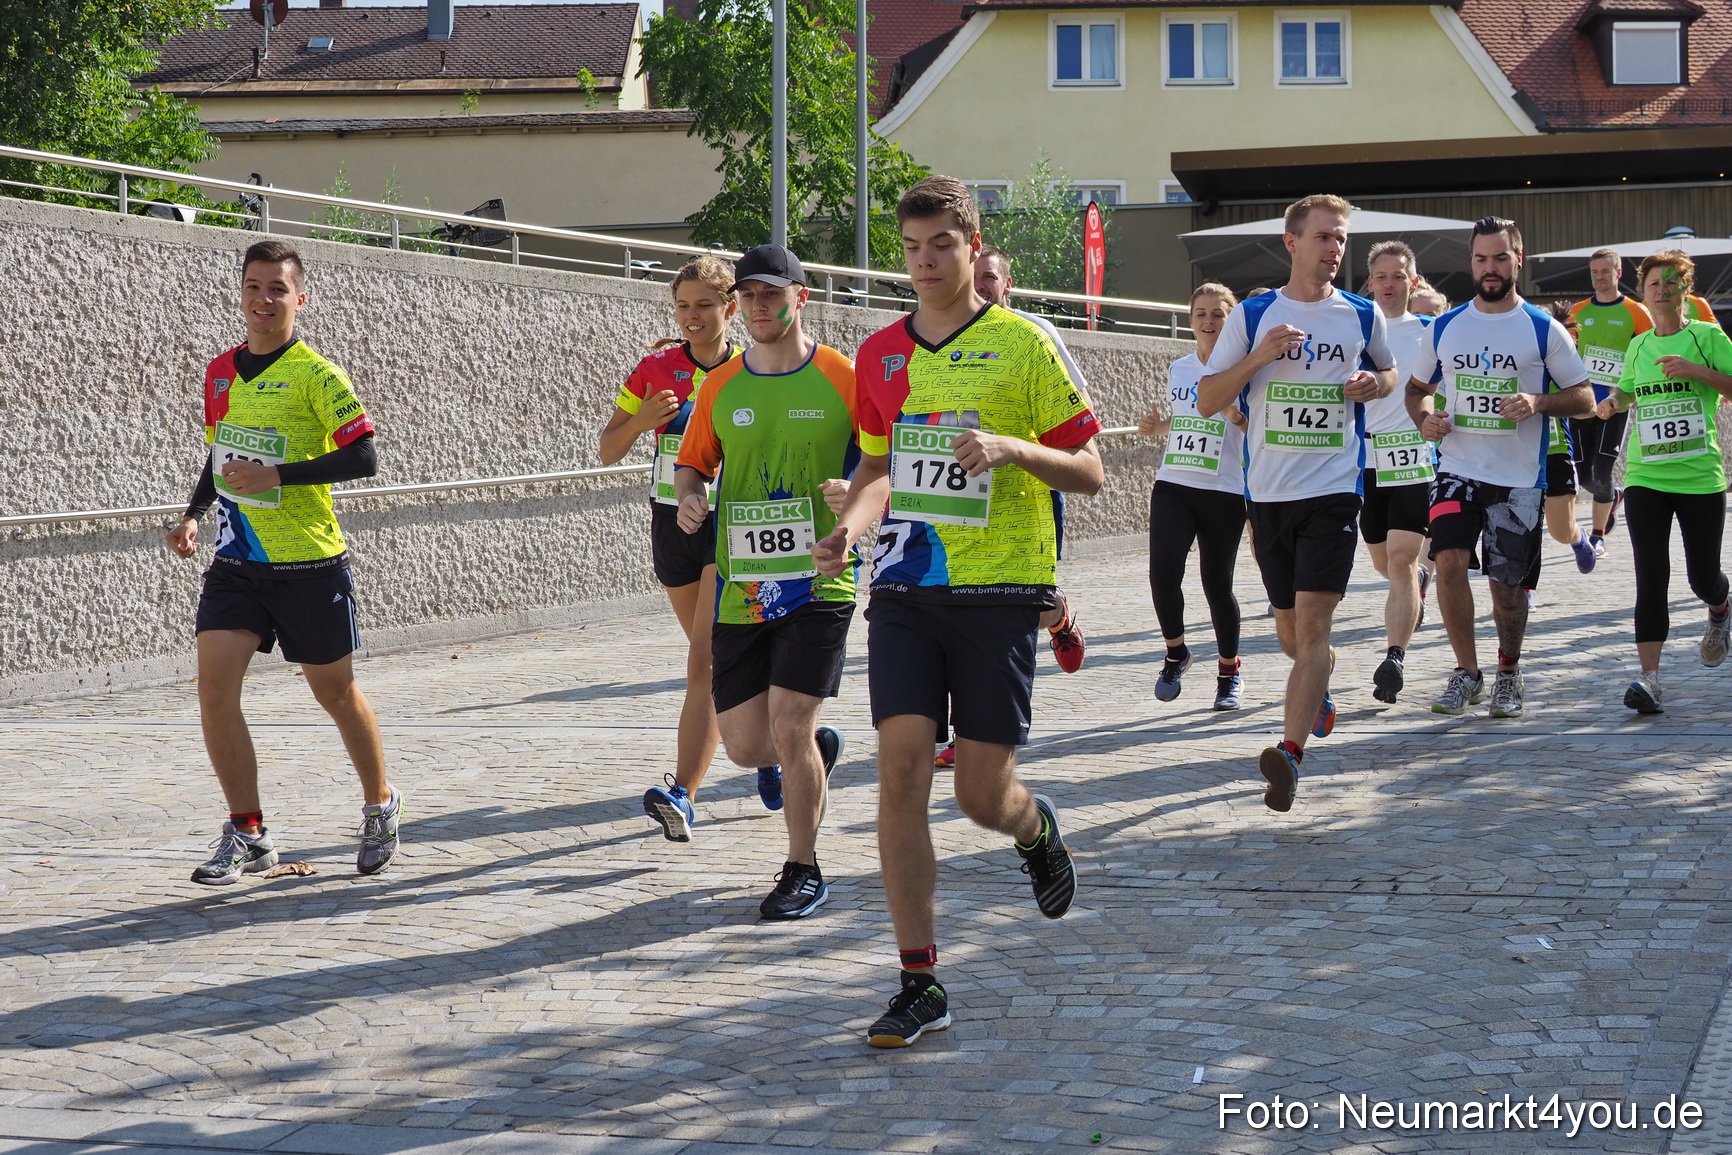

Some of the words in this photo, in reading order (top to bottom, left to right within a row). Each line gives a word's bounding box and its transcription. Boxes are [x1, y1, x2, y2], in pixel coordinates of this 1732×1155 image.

[1587, 348, 1622, 360] BOCK
[1591, 360, 1615, 373] 127
[1273, 384, 1340, 400] BOCK
[1460, 376, 1513, 392] BOCK
[1636, 382, 1691, 397] BRANDL
[336, 401, 361, 418] BMW
[1466, 396, 1501, 414] 138
[1641, 401, 1698, 419] BOCK
[789, 410, 825, 419] BOCK
[1283, 407, 1328, 428] 142
[1174, 418, 1219, 434] BOCK
[1467, 418, 1500, 428] PETER
[1652, 420, 1690, 440] 183
[219, 426, 277, 453] BOCK
[901, 430, 957, 450] BOC
[1177, 435, 1207, 453] 141
[1278, 434, 1330, 445] DOMINIK
[1377, 433, 1423, 447] BOCK
[1173, 456, 1205, 466] BIANCA
[1387, 449, 1418, 467] 137
[912, 459, 967, 491] 178
[1394, 470, 1419, 479] SVEN
[733, 503, 803, 522] BOCK
[744, 528, 796, 554] 188
